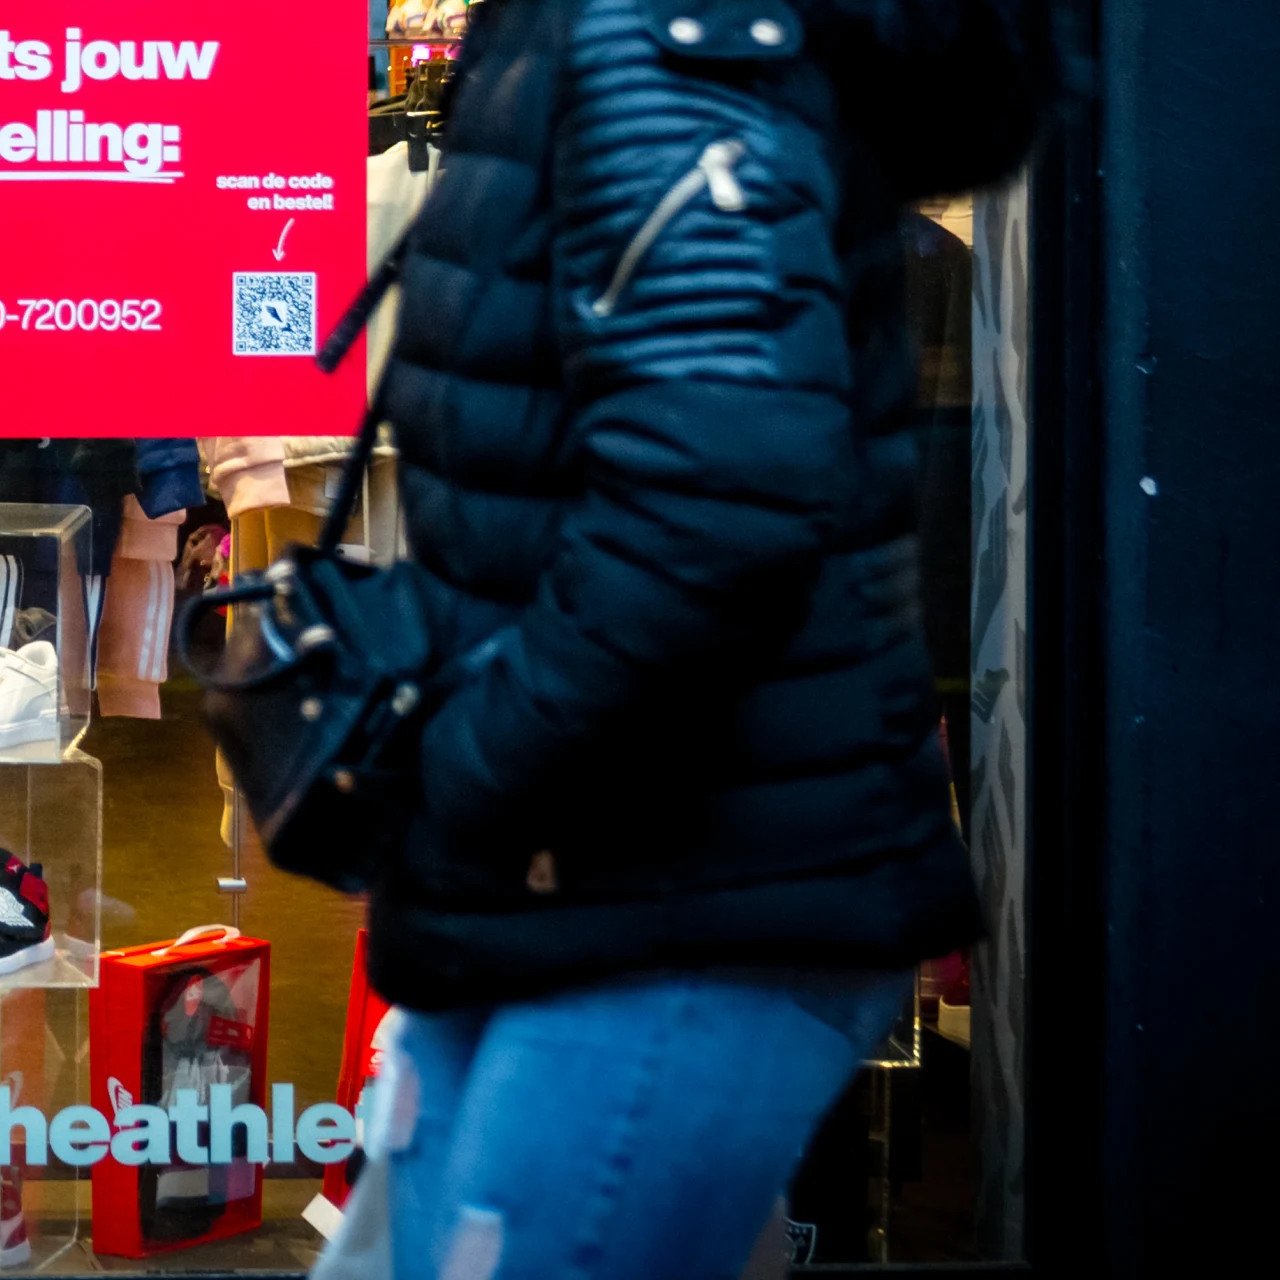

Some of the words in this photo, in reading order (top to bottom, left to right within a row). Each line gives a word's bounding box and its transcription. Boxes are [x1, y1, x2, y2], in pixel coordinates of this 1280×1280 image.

[60, 27, 220, 93] jouw
[216, 175, 260, 189] scan
[262, 172, 286, 189] de
[288, 172, 334, 189] code
[247, 196, 271, 210] en
[273, 193, 334, 210] bestel!
